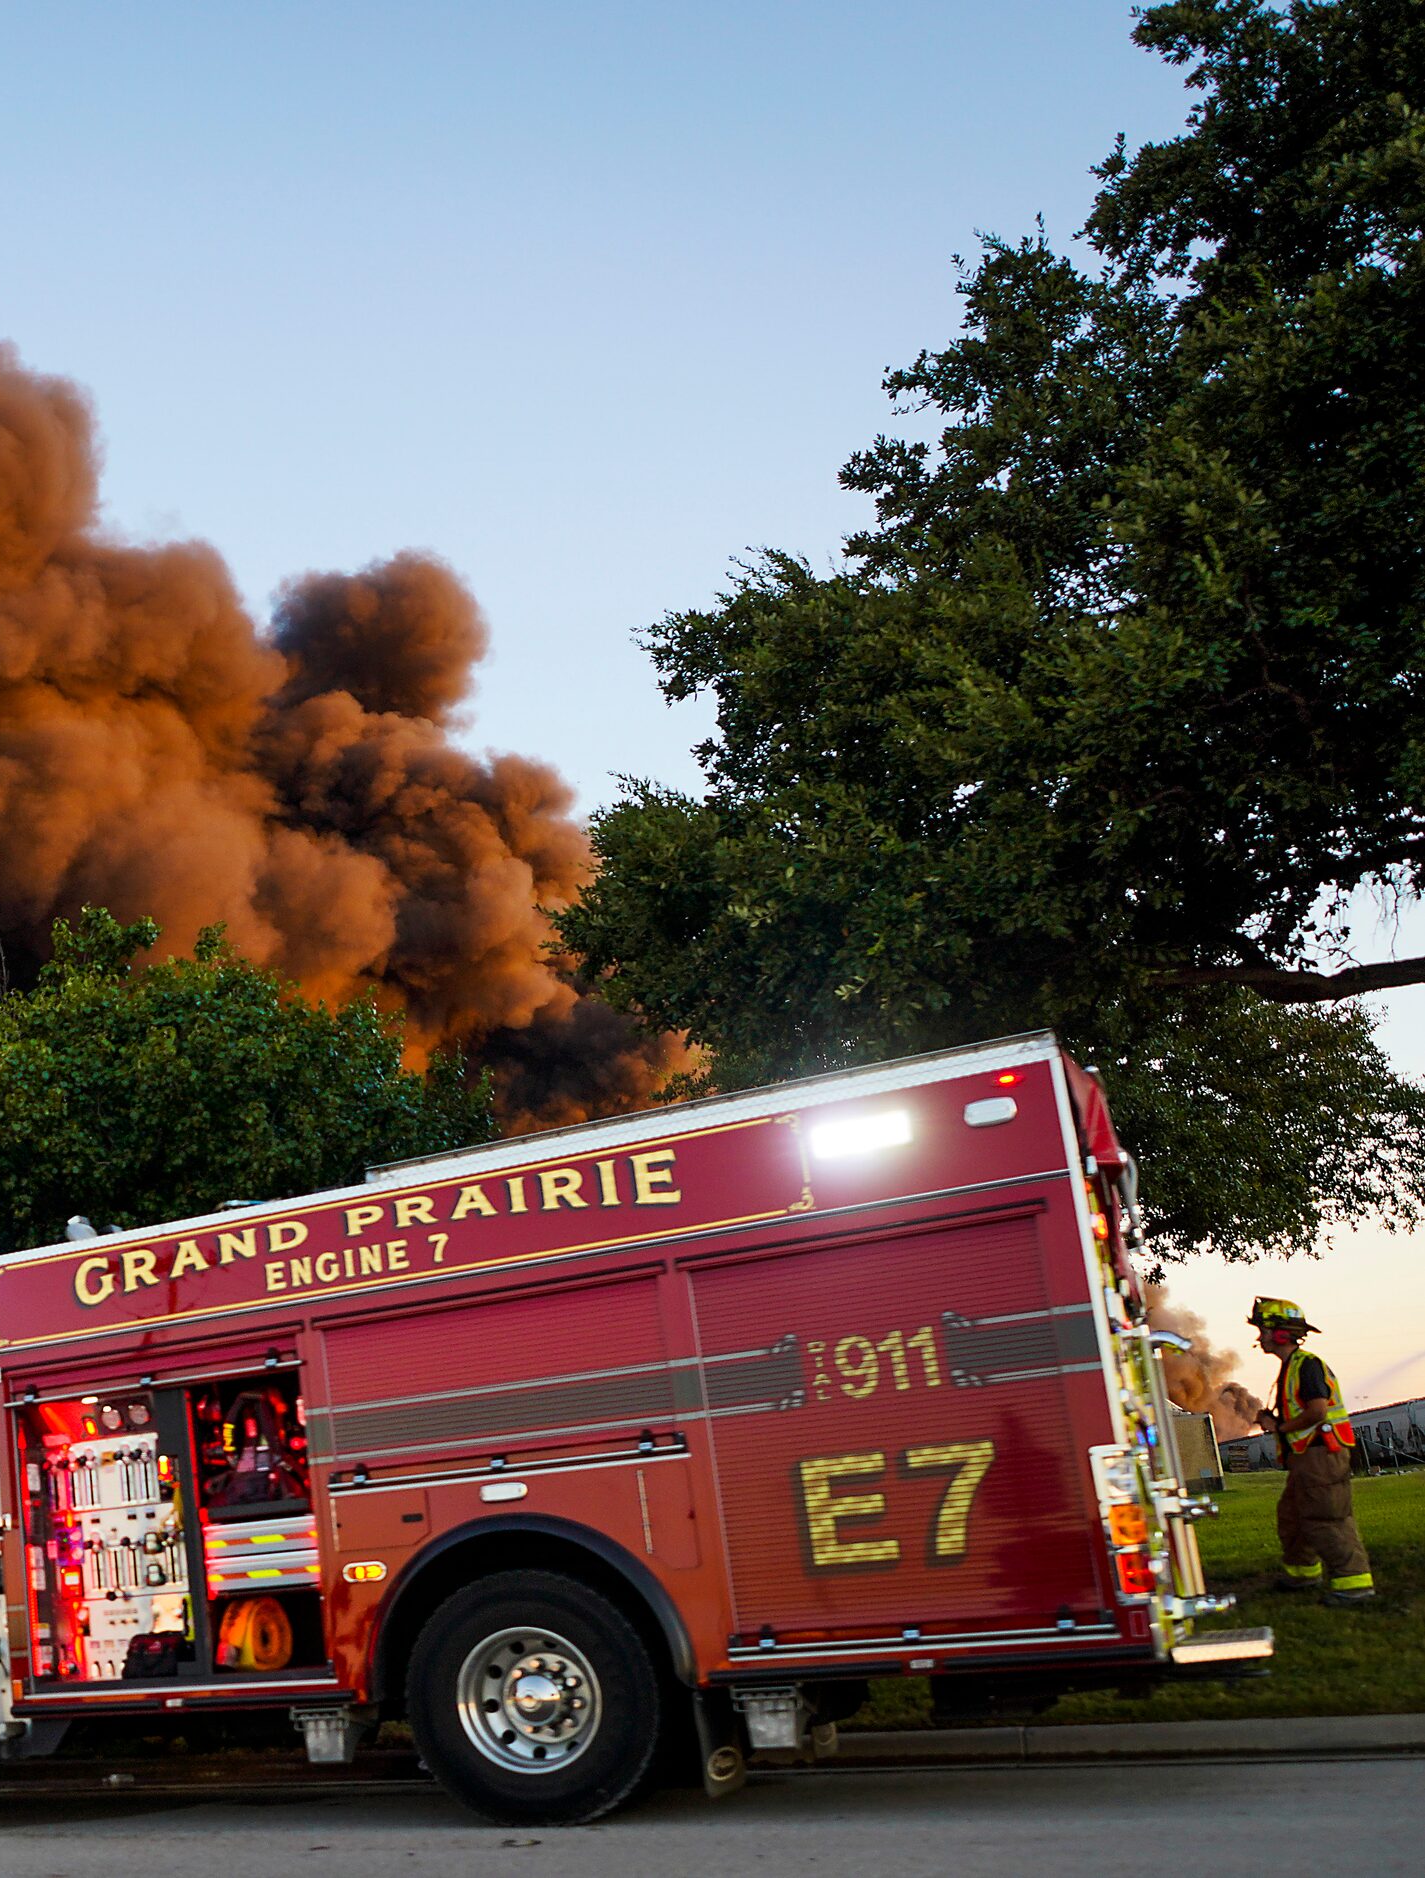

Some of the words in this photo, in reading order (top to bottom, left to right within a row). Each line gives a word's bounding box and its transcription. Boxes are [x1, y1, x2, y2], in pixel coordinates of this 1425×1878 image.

[74, 1220, 309, 1307] GRAND
[344, 1148, 682, 1237] PRAIRIE
[264, 1239, 410, 1292] ENGINE
[427, 1233, 450, 1263] 7
[833, 1326, 942, 1398] 911
[797, 1440, 995, 1567] E7
